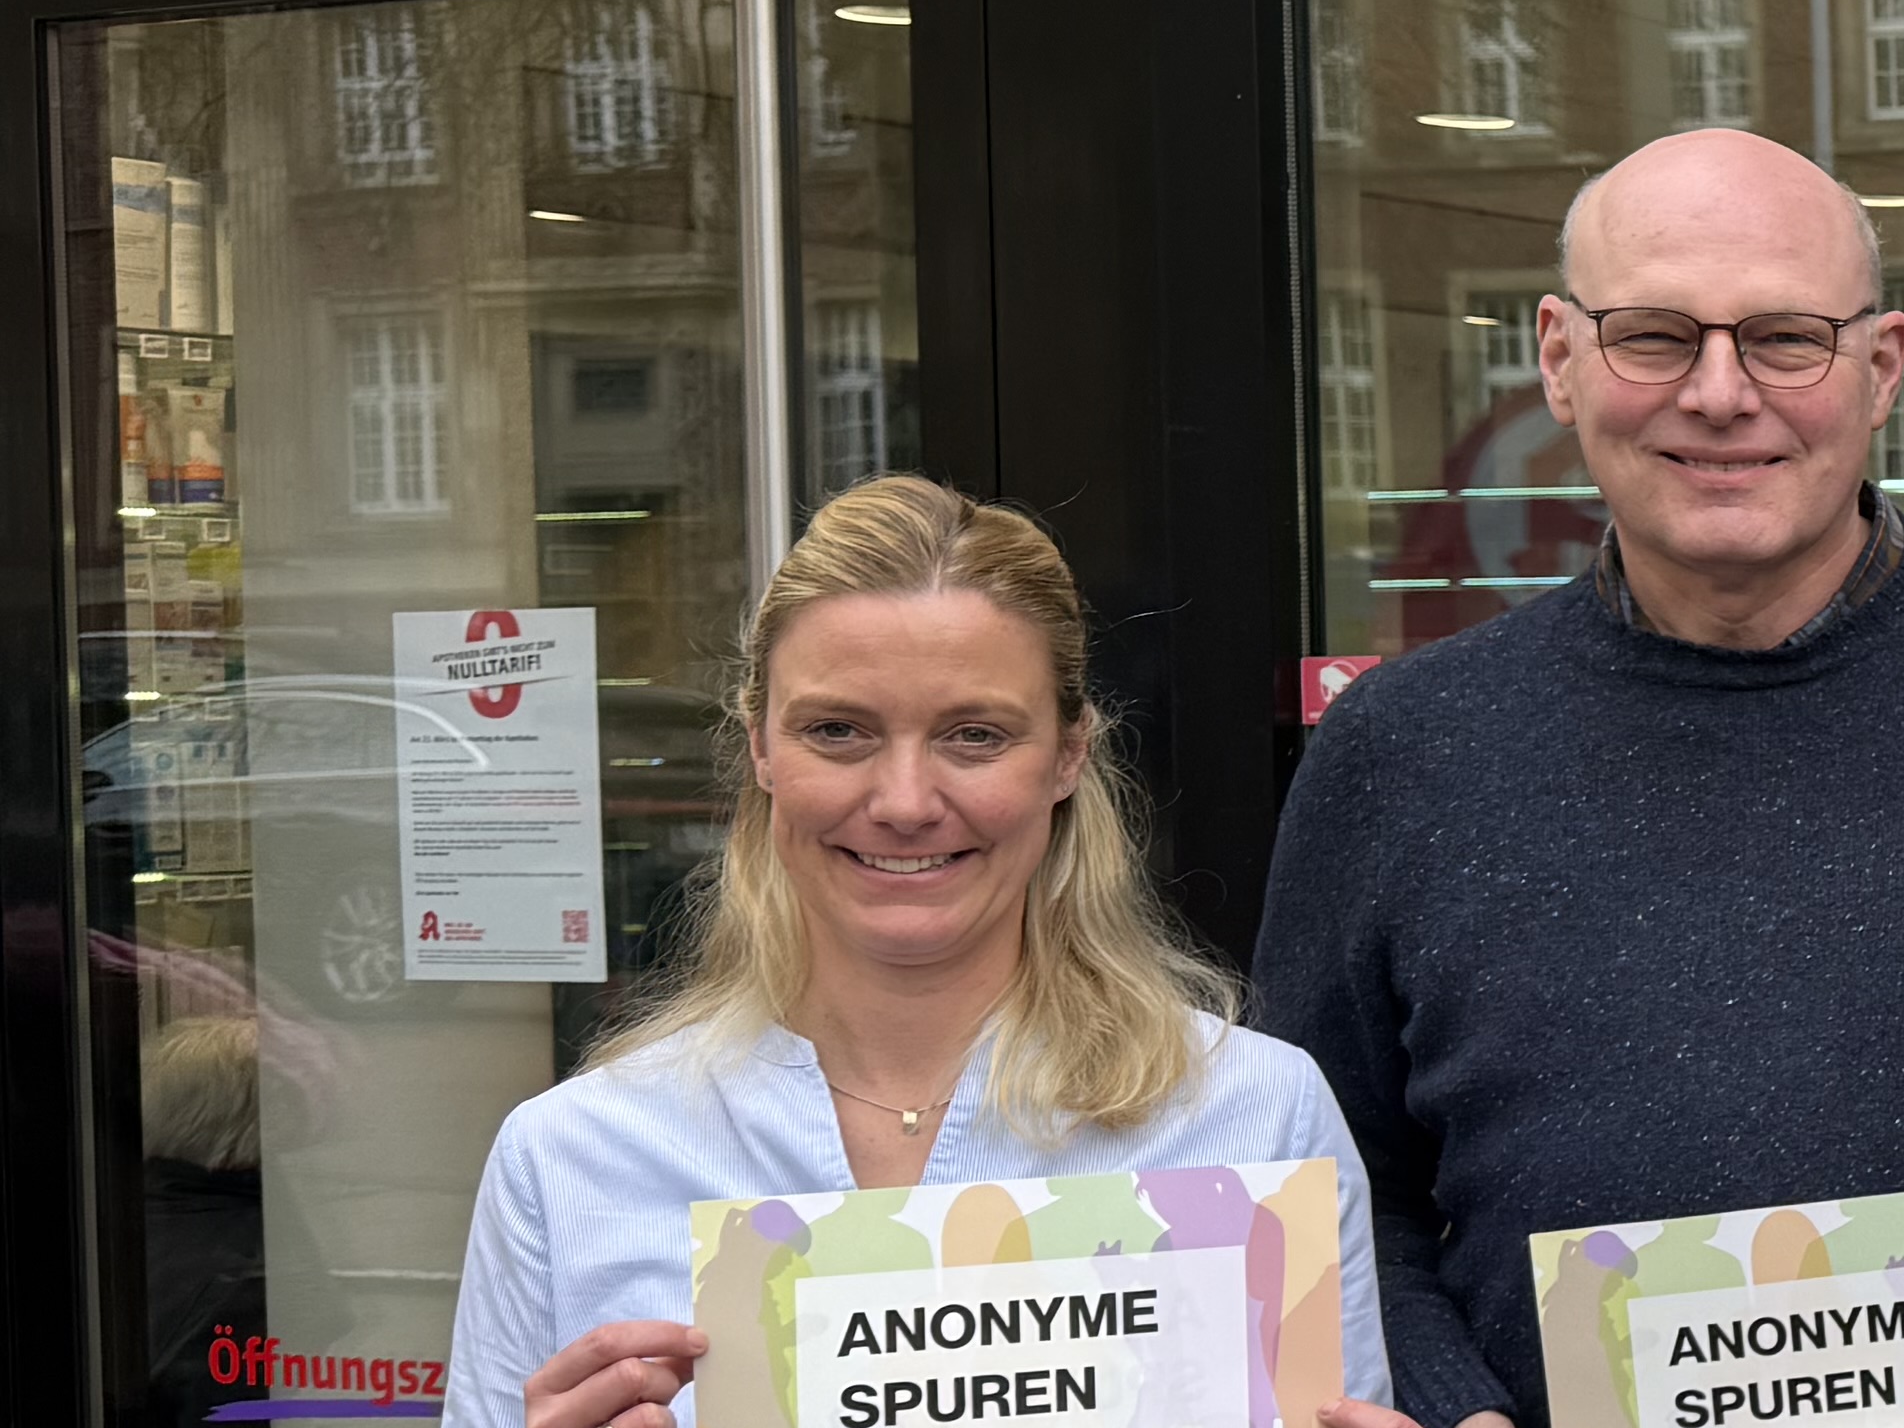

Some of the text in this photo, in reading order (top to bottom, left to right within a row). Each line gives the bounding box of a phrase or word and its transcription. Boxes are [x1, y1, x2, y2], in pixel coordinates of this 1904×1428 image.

[447, 654, 542, 681] NULLTARIF!
[837, 1289, 1159, 1358] ANONYME
[209, 1324, 447, 1409] Öffnungsz
